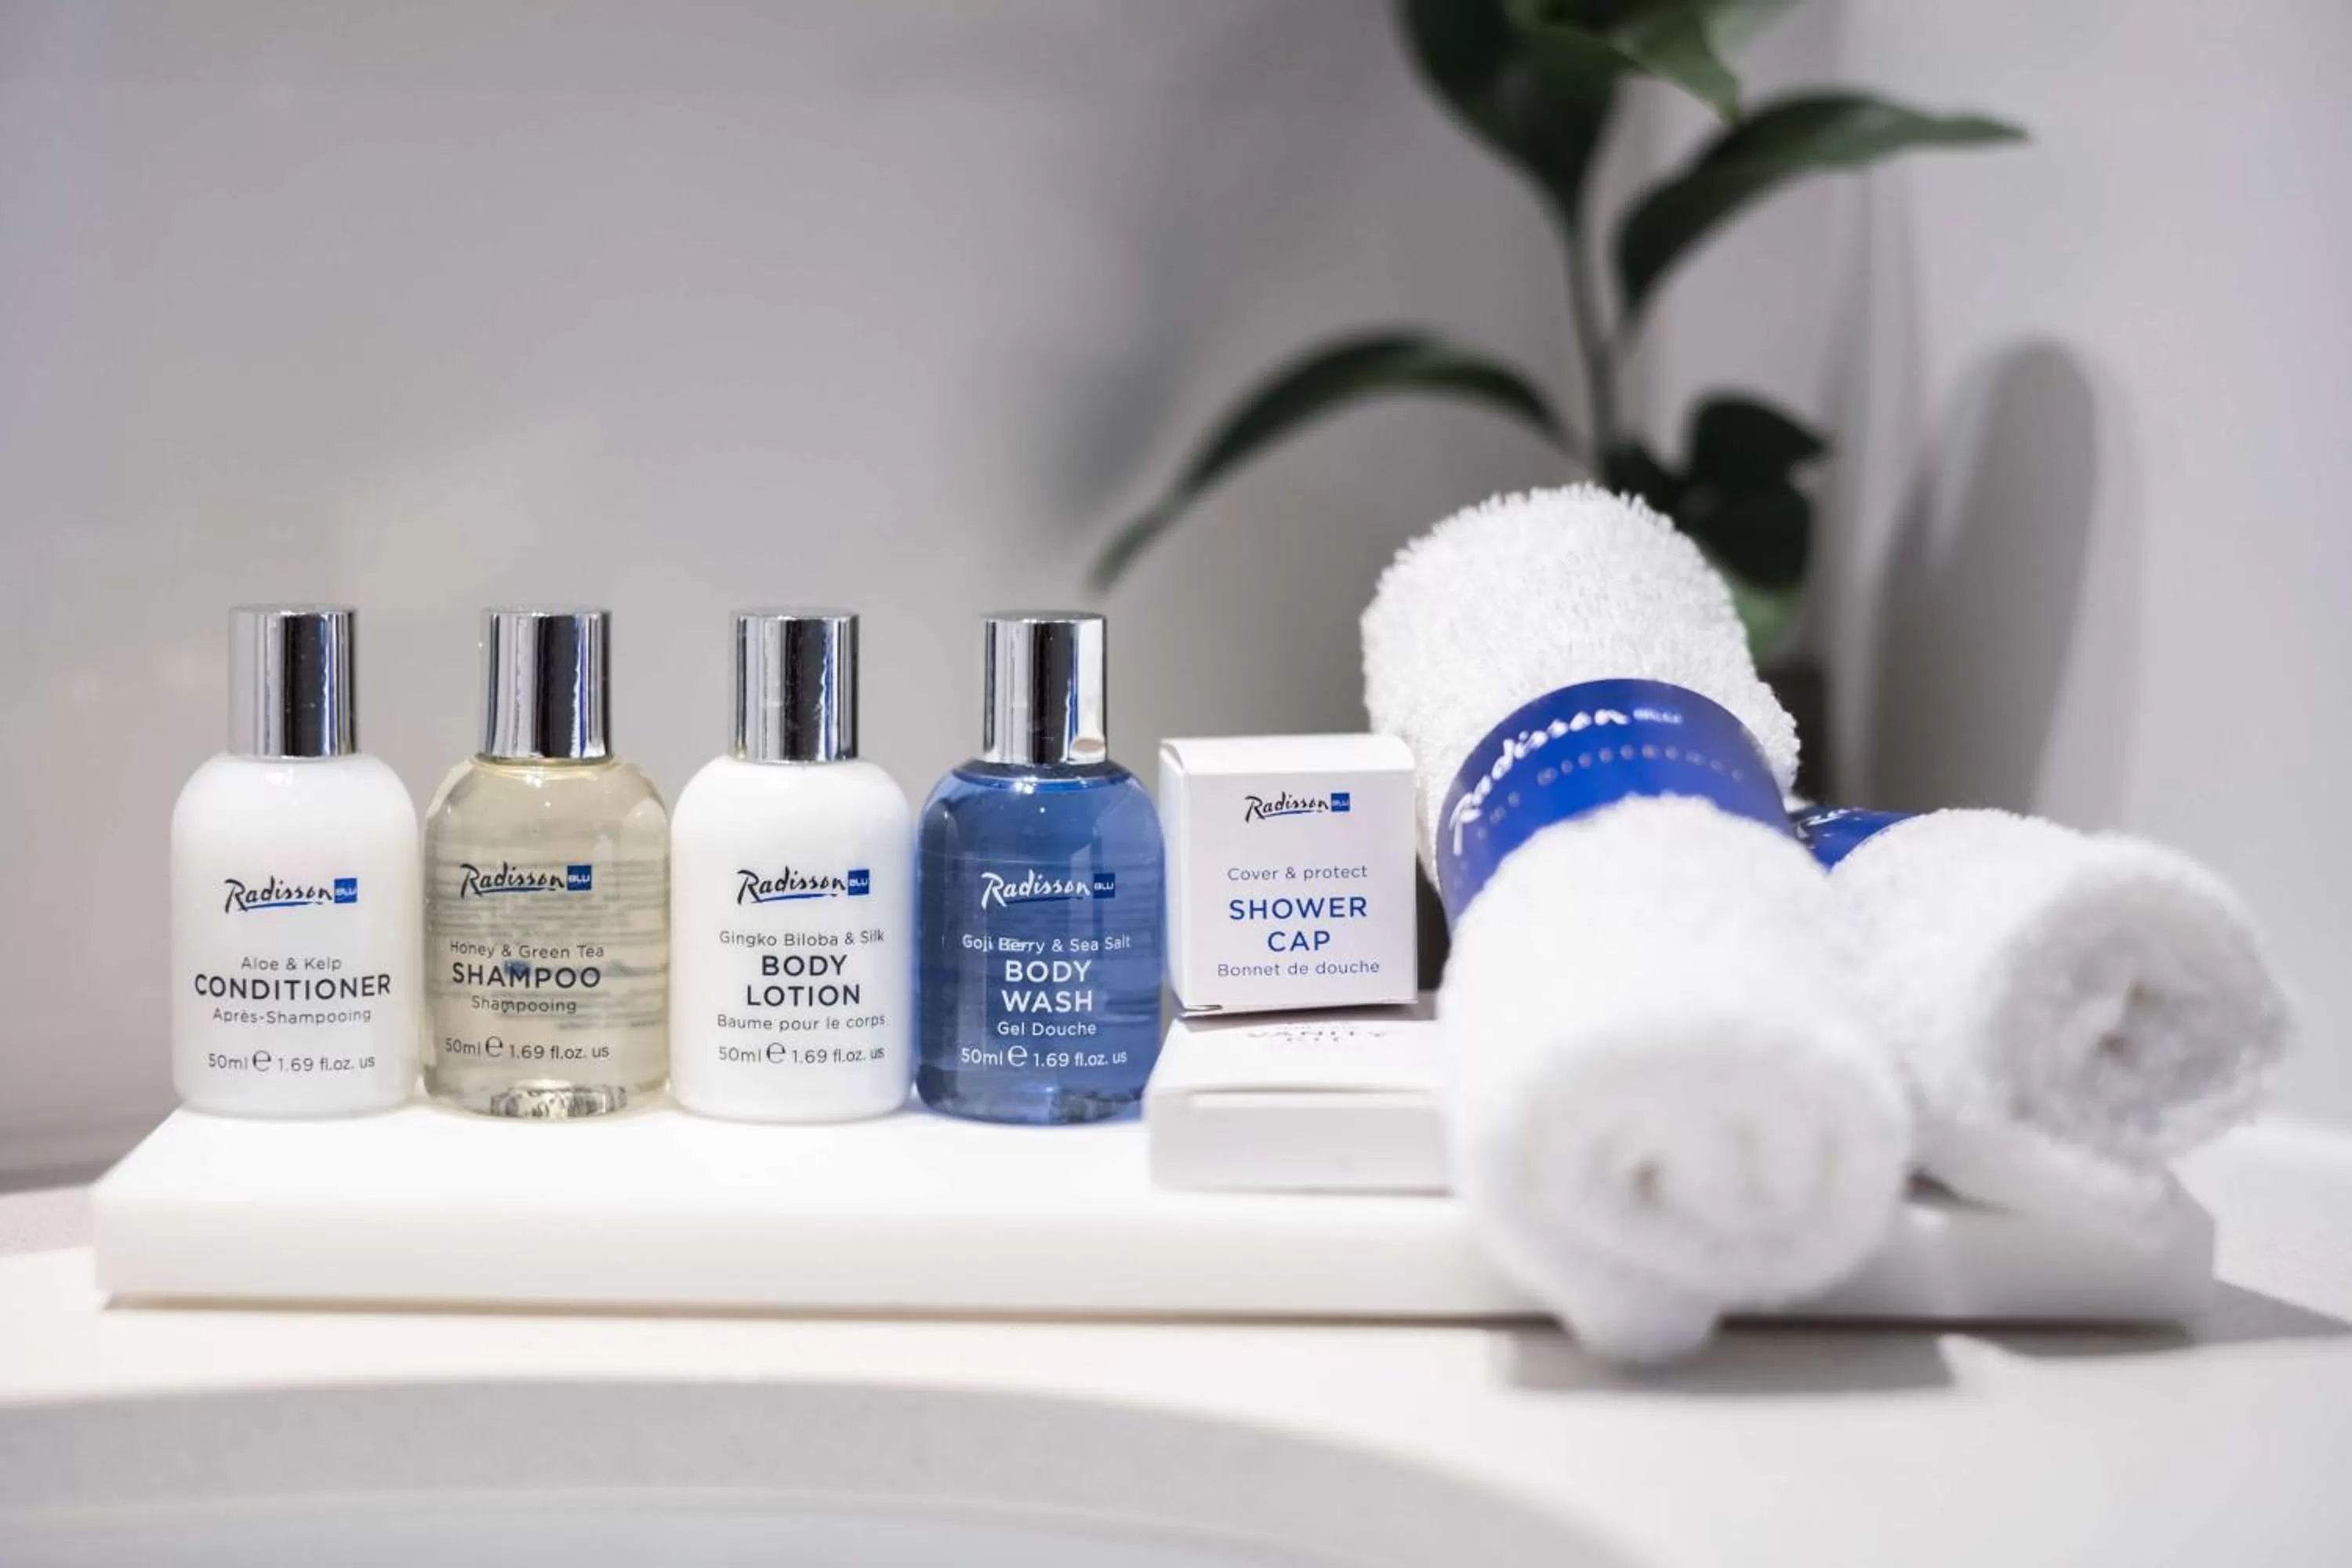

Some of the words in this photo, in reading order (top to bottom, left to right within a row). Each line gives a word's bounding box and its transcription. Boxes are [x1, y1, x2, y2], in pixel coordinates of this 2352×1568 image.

[1245, 792, 1330, 823] Radisson
[459, 861, 564, 898] Radisson
[1227, 867, 1278, 881] Cover
[1286, 867, 1296, 880] &
[1304, 865, 1368, 883] protect
[224, 875, 332, 913] Radisson
[736, 866, 846, 905] Radisson
[981, 869, 1091, 909] Radisson
[1229, 896, 1368, 920] SHOWER
[719, 931, 777, 948] Gingko
[784, 933, 838, 946] Biloba
[845, 932, 855, 945] &
[860, 929, 885, 943] Silk
[962, 934, 993, 953] Goji
[998, 937, 1045, 954] Berry
[1051, 939, 1063, 952] &
[1069, 938, 1098, 951] Sea
[1105, 935, 1131, 950] Salt
[1267, 931, 1330, 953] CAP
[450, 941, 495, 958] Honey
[502, 944, 512, 957] &
[518, 945, 571, 959] Green
[577, 945, 604, 957] Tea
[241, 956, 279, 971] Aloe
[285, 957, 296, 970] &
[304, 956, 343, 973] Kelp
[762, 955, 848, 976] BODY
[1005, 960, 1092, 982] BODY
[1218, 964, 1279, 977] Bonnet
[1287, 961, 1308, 975] de
[1316, 961, 1380, 975] douche
[452, 962, 601, 989] SHAMPOO
[194, 973, 391, 1000] CONDITIONER
[747, 984, 861, 1007] LOTION
[471, 995, 577, 1014] Shampooing
[1001, 990, 1092, 1013] WASH
[212, 1007, 372, 1025] Après-Shampooing
[717, 1014, 772, 1030] Baume
[779, 1018, 819, 1032] pour
[826, 1015, 840, 1029] le
[846, 1014, 885, 1029] corps
[997, 1022, 1025, 1036] Gel
[1032, 1021, 1097, 1036] Douche
[445, 1037, 481, 1055] 50ml
[510, 1044, 545, 1059] 1.69
[719, 1047, 761, 1062] 50ml
[792, 1049, 827, 1064] 1.69
[960, 1047, 1003, 1065] 50ml
[1033, 1053, 1069, 1066] 1.69
[208, 1053, 248, 1069] 50ml
[278, 1058, 314, 1072] 1.69
